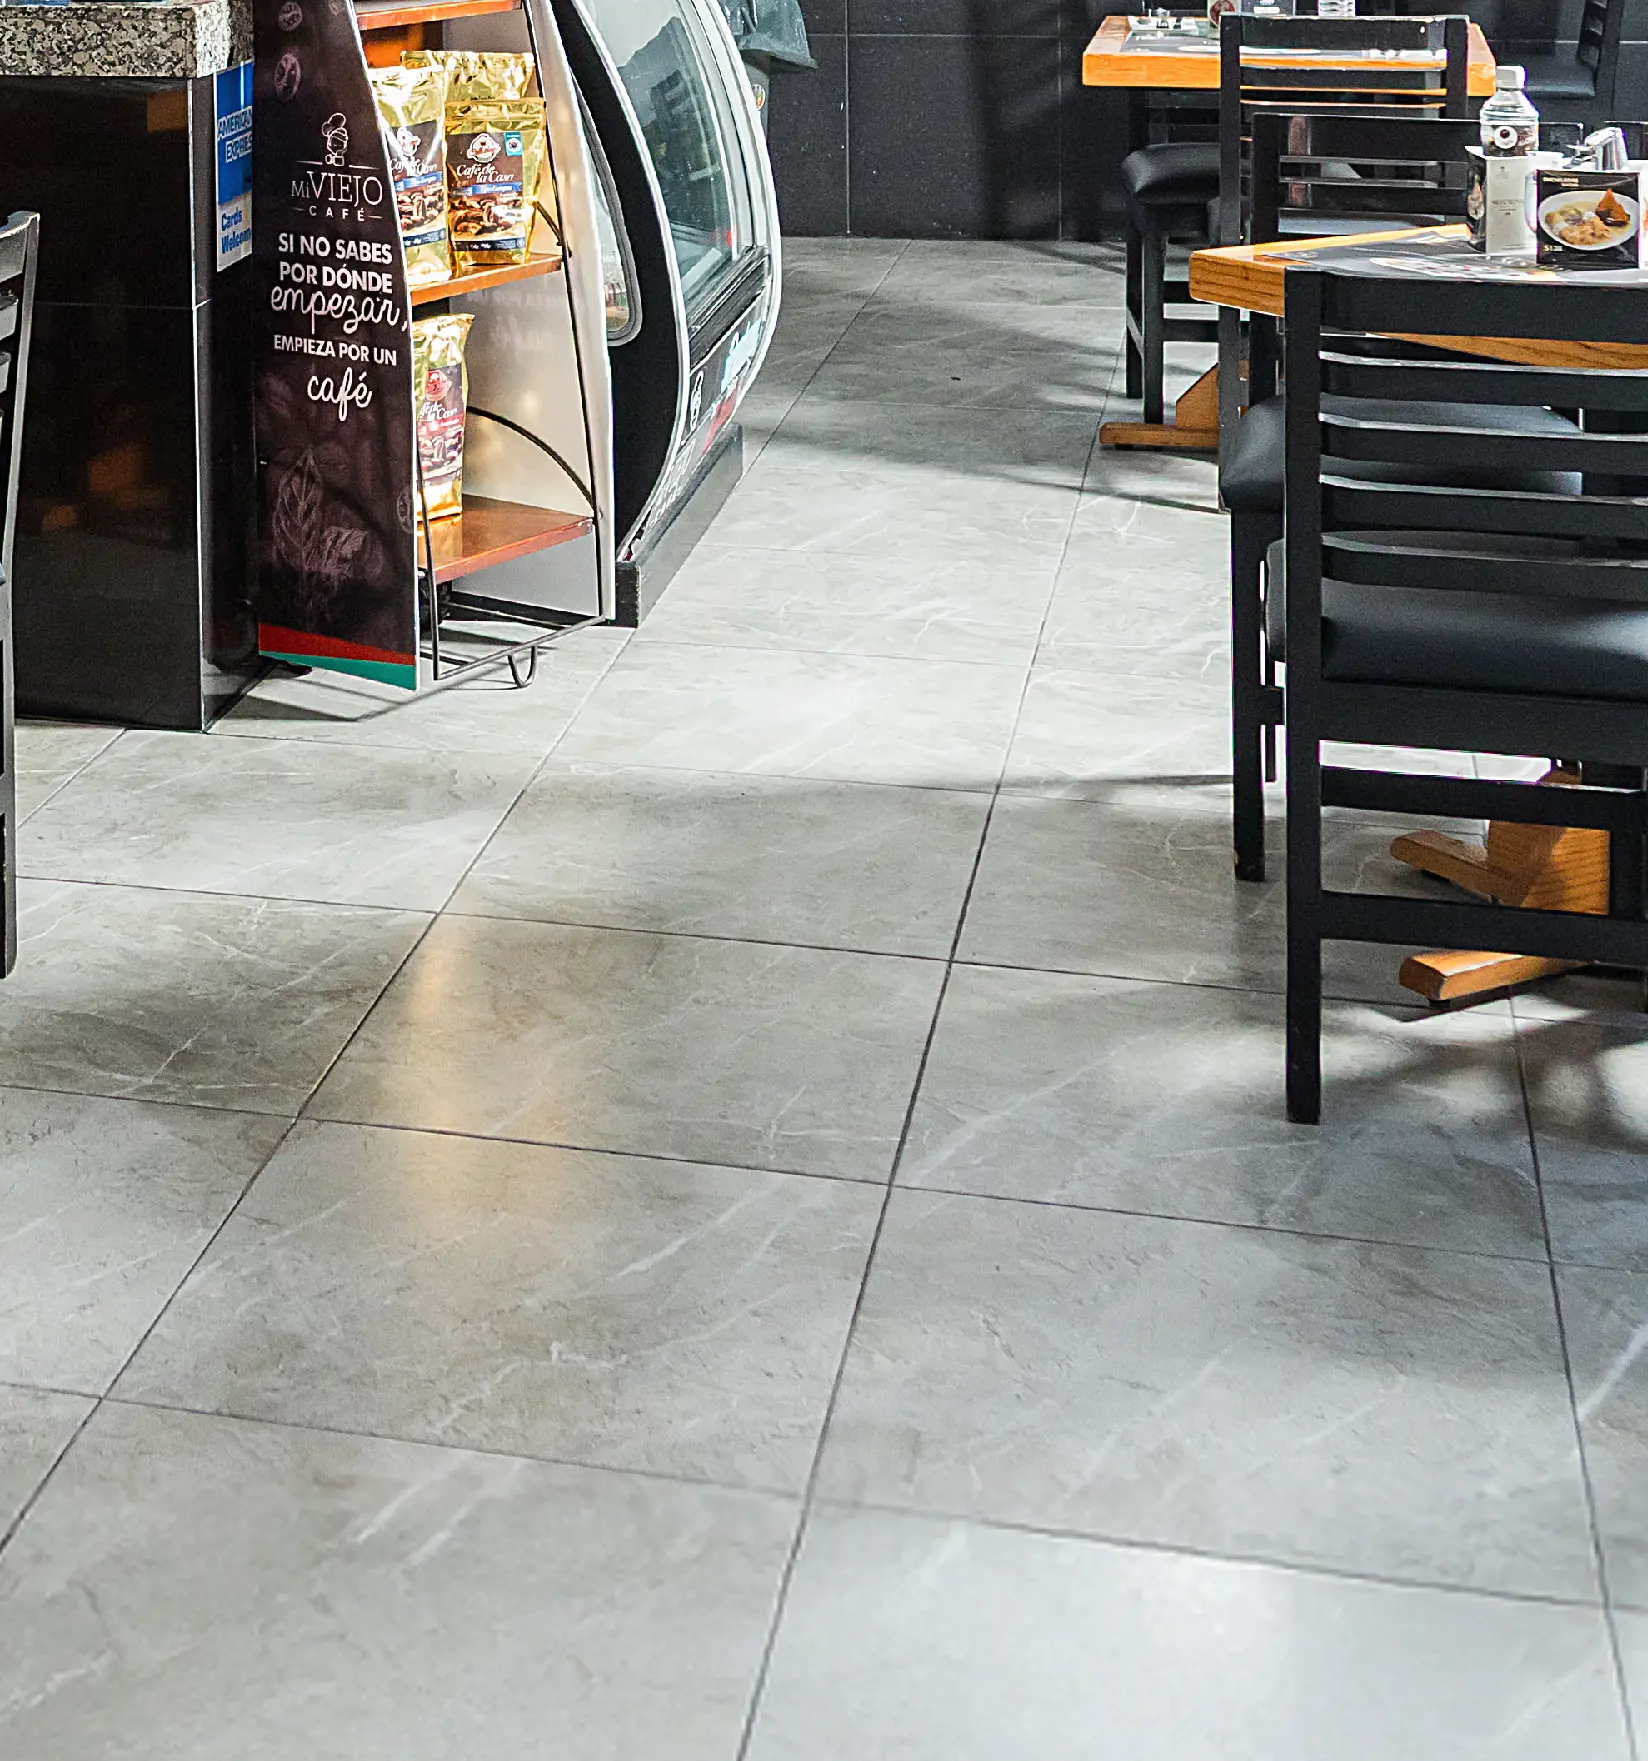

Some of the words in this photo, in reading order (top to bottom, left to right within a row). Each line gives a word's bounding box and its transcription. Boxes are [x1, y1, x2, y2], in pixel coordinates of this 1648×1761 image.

[307, 171, 383, 207] VIEJO
[221, 209, 243, 232] Cards
[308, 205, 365, 222] CAFÉ
[278, 232, 294, 253] SI
[301, 235, 331, 257] NO
[335, 239, 393, 265] SABES
[280, 261, 318, 285] POR
[322, 263, 393, 294] DÓNDE
[273, 334, 336, 358] EMPIEZA
[339, 342, 370, 362] POR
[373, 348, 397, 366] UN
[307, 366, 373, 421] café
